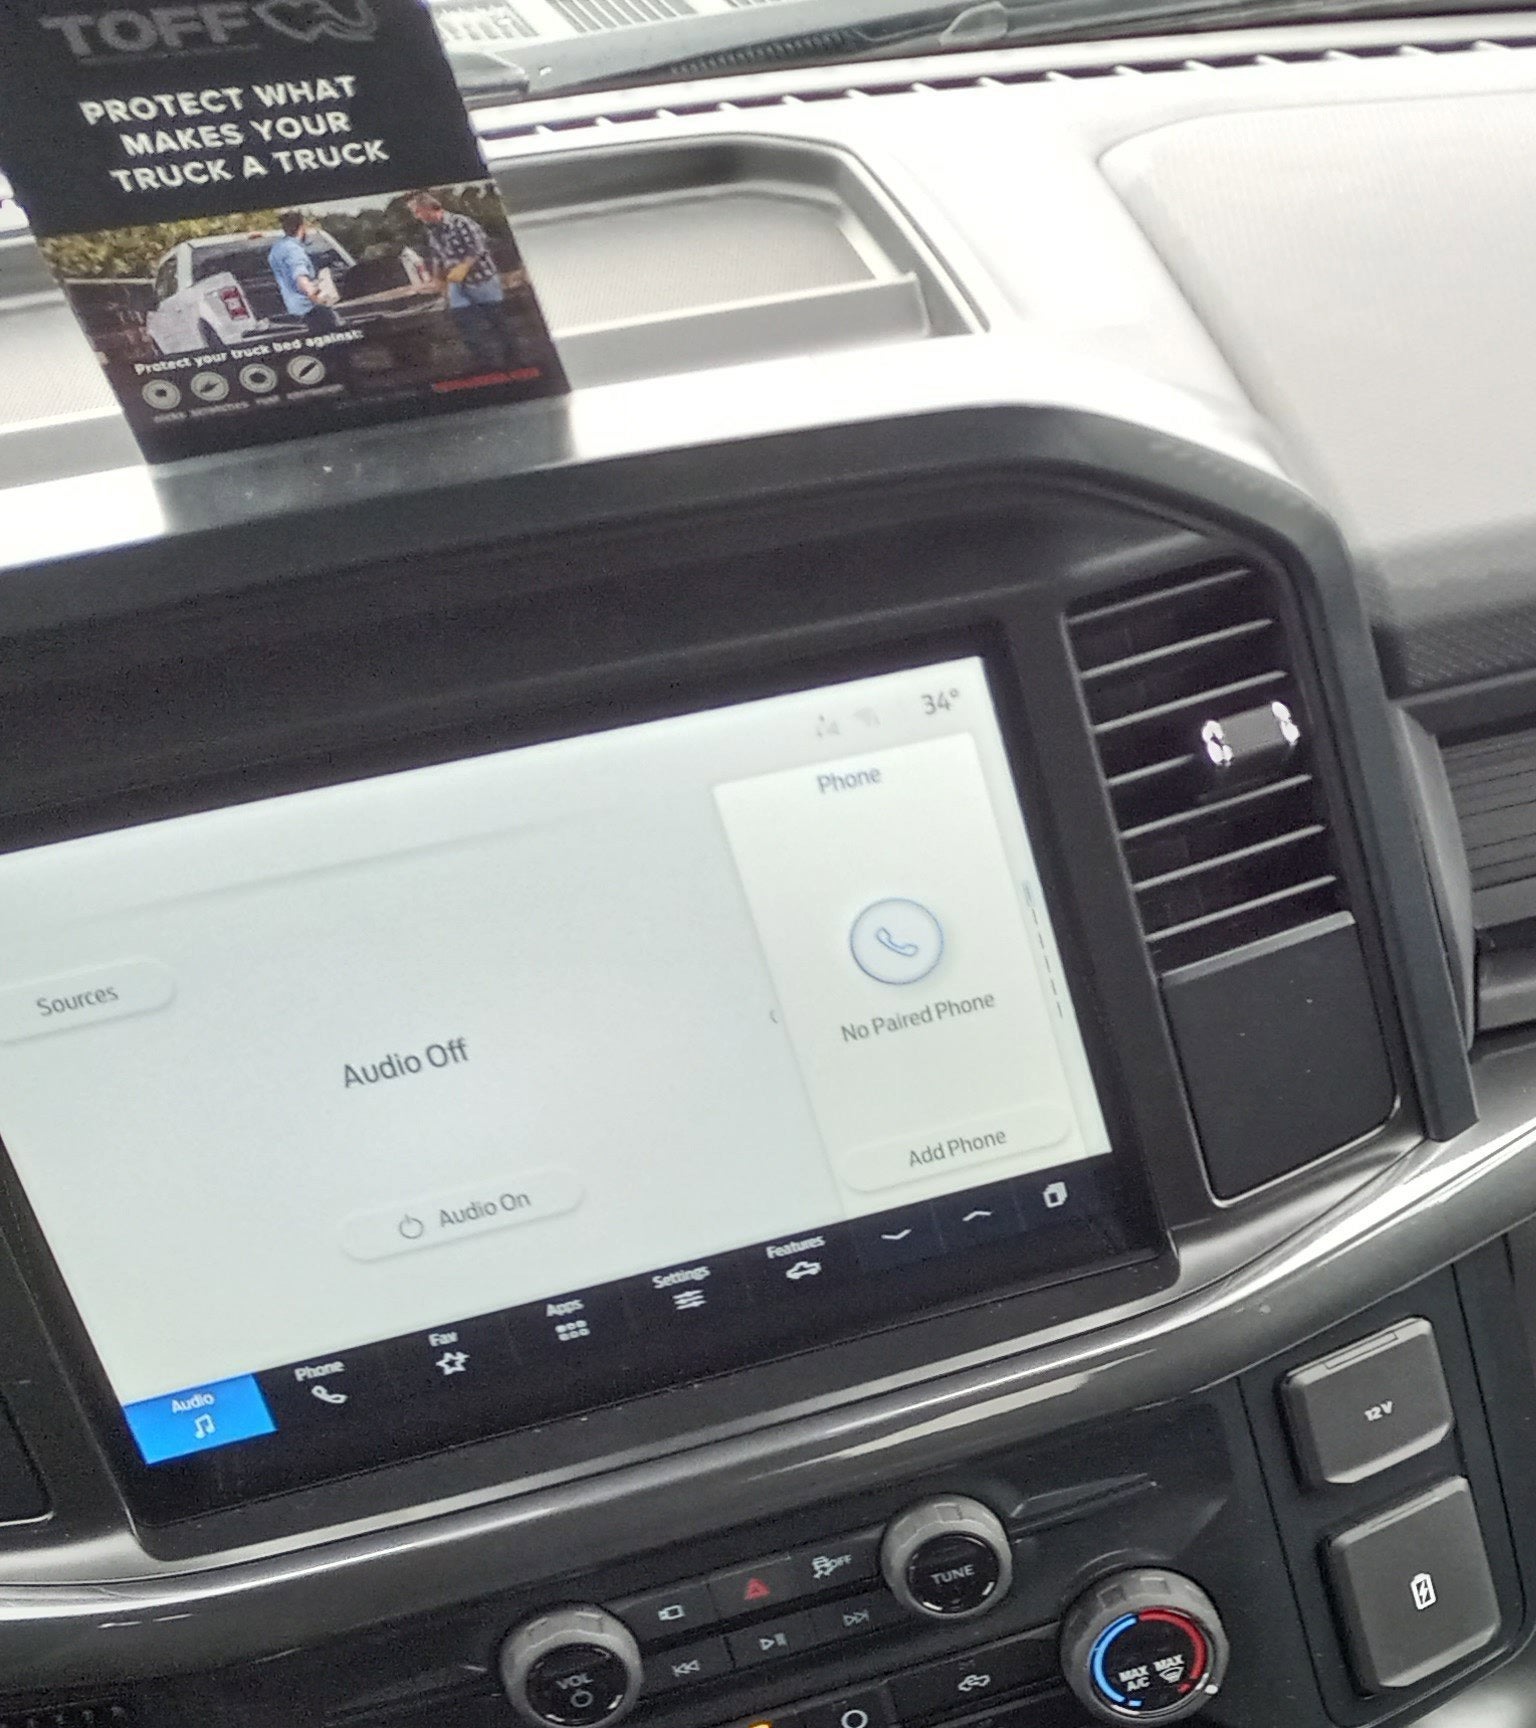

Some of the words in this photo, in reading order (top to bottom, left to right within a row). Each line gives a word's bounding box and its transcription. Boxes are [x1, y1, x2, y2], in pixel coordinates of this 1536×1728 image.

[79, 86, 244, 126] PROTECT
[251, 74, 357, 108] WHAT
[119, 123, 244, 156] MAKES
[250, 110, 351, 142] YOUR
[109, 159, 234, 193] TRUCK
[242, 155, 269, 180] A
[271, 139, 390, 174] TRUCK
[134, 357, 192, 376] Protect
[194, 351, 227, 369] your
[231, 344, 270, 360] truck
[273, 338, 302, 353] bed
[305, 329, 364, 348] against:
[921, 687, 959, 716] 34°
[817, 765, 882, 796] Phone
[36, 984, 119, 1018] Sources
[840, 1023, 869, 1043] No
[871, 1005, 932, 1037] Paired
[935, 990, 995, 1024] Phone
[342, 1050, 421, 1088] Audio
[425, 1036, 470, 1068] Off
[908, 1143, 944, 1168] Add
[948, 1127, 1007, 1160] Phone
[439, 1197, 497, 1229] Audio
[500, 1188, 531, 1213] On
[766, 1234, 825, 1261] Features
[653, 1264, 711, 1291] Settings
[545, 1298, 585, 1319] Apps
[428, 1329, 458, 1348] Fav
[294, 1357, 345, 1382] Phone
[171, 1391, 214, 1415] Audio
[1365, 1399, 1395, 1422] 12V
[830, 1553, 852, 1568] OFF
[930, 1564, 975, 1585] TUNE
[556, 1672, 594, 1690] VOL
[1118, 1665, 1150, 1683] MAX
[1153, 1654, 1185, 1672] MAX
[1127, 1676, 1150, 1692] A/C
